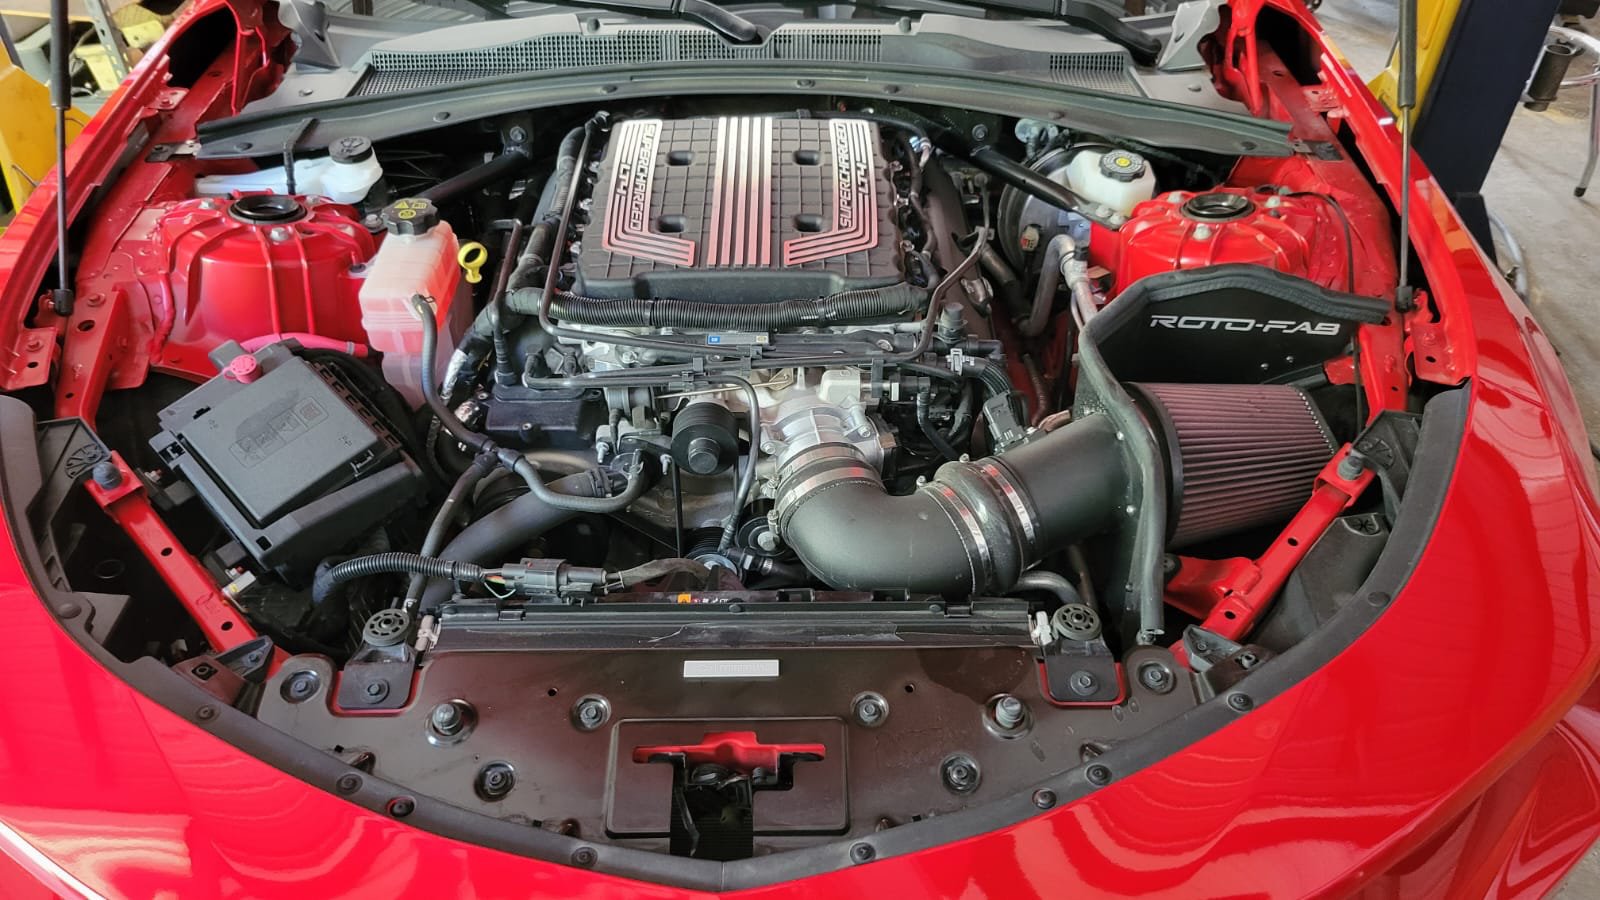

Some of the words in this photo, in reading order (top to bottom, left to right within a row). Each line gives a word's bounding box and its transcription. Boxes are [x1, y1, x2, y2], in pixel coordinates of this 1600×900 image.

[616, 164, 631, 195] LT4
[630, 124, 657, 231] SUPERCHARGED
[838, 123, 853, 228] SUPERCHARGED
[857, 162, 869, 194] LT4
[1150, 315, 1340, 336] ROTO-FAB
